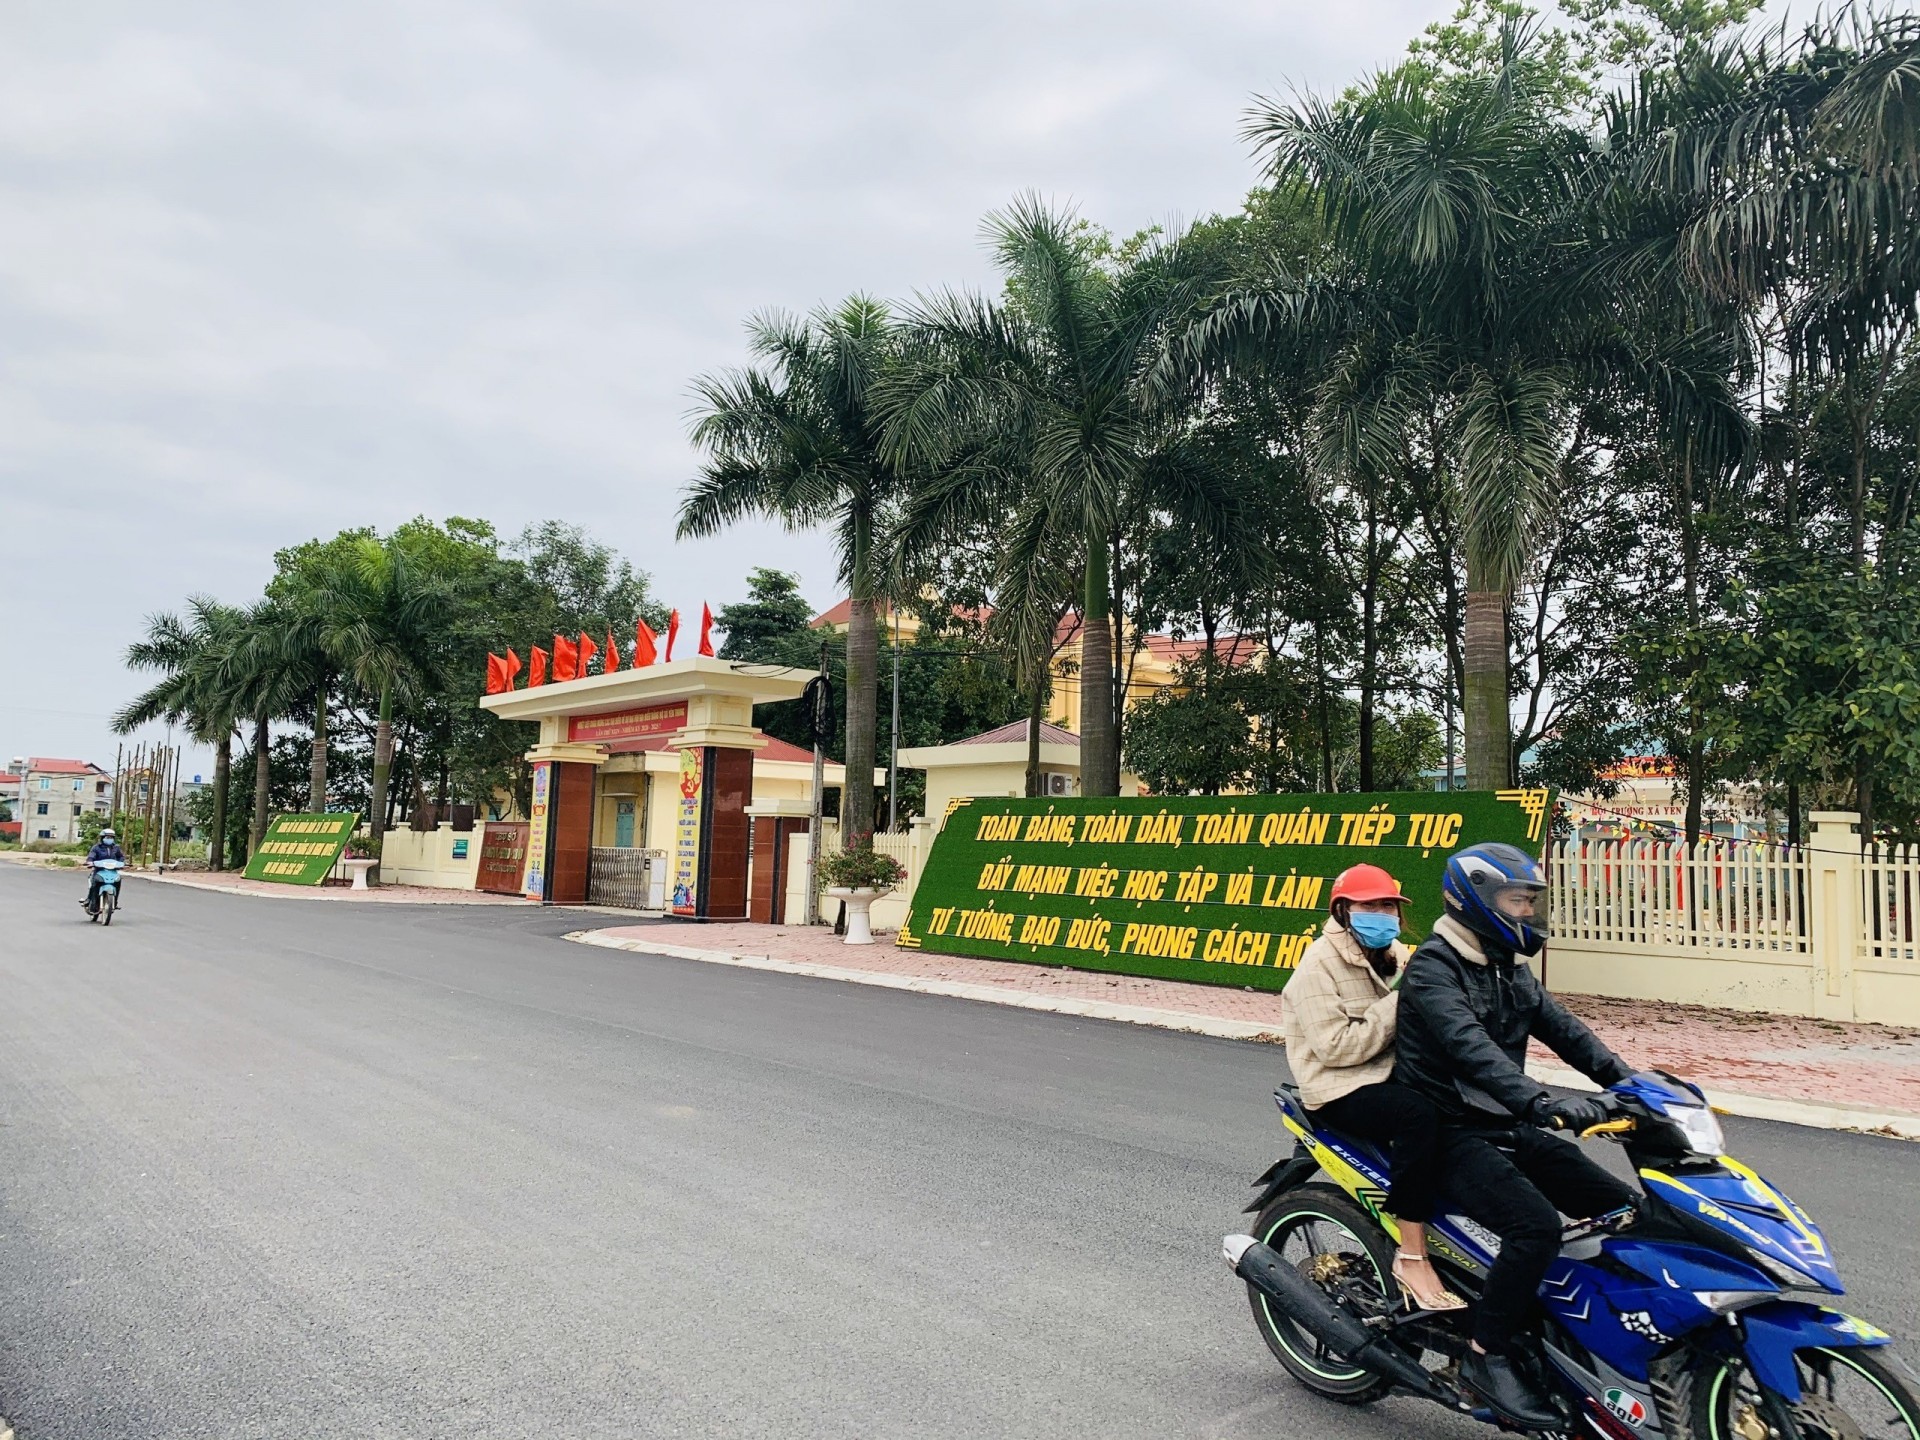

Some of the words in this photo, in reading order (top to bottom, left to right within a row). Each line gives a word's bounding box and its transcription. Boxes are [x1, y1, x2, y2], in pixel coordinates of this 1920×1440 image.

[976, 809, 1022, 841] TOÀN
[1024, 805, 1076, 847] ĐẢNG,
[1080, 809, 1132, 842] TOÀN
[1134, 809, 1183, 848] DÂN,
[1192, 806, 1254, 844] TOÀN
[1259, 806, 1330, 847] QUÂN
[1337, 803, 1395, 846] TIẾP
[1406, 813, 1463, 858] TỤC
[977, 855, 1015, 890] ĐẨY
[1013, 865, 1071, 900] MẠNH
[1075, 861, 1119, 905] VIỆC
[1122, 869, 1168, 909] HỌC
[1174, 865, 1218, 913] TẬP
[1224, 865, 1254, 905] VÀ
[1261, 867, 1323, 910] LÀM
[927, 907, 955, 936] TƯ
[955, 899, 1015, 947] TƯỞNG,
[1019, 915, 1060, 952] ĐẠO
[1065, 913, 1111, 957] ĐỨC,
[1120, 923, 1198, 960] PHONG
[1203, 922, 1271, 967] CÁCH
[1331, 1144, 1392, 1188] EXCITER
